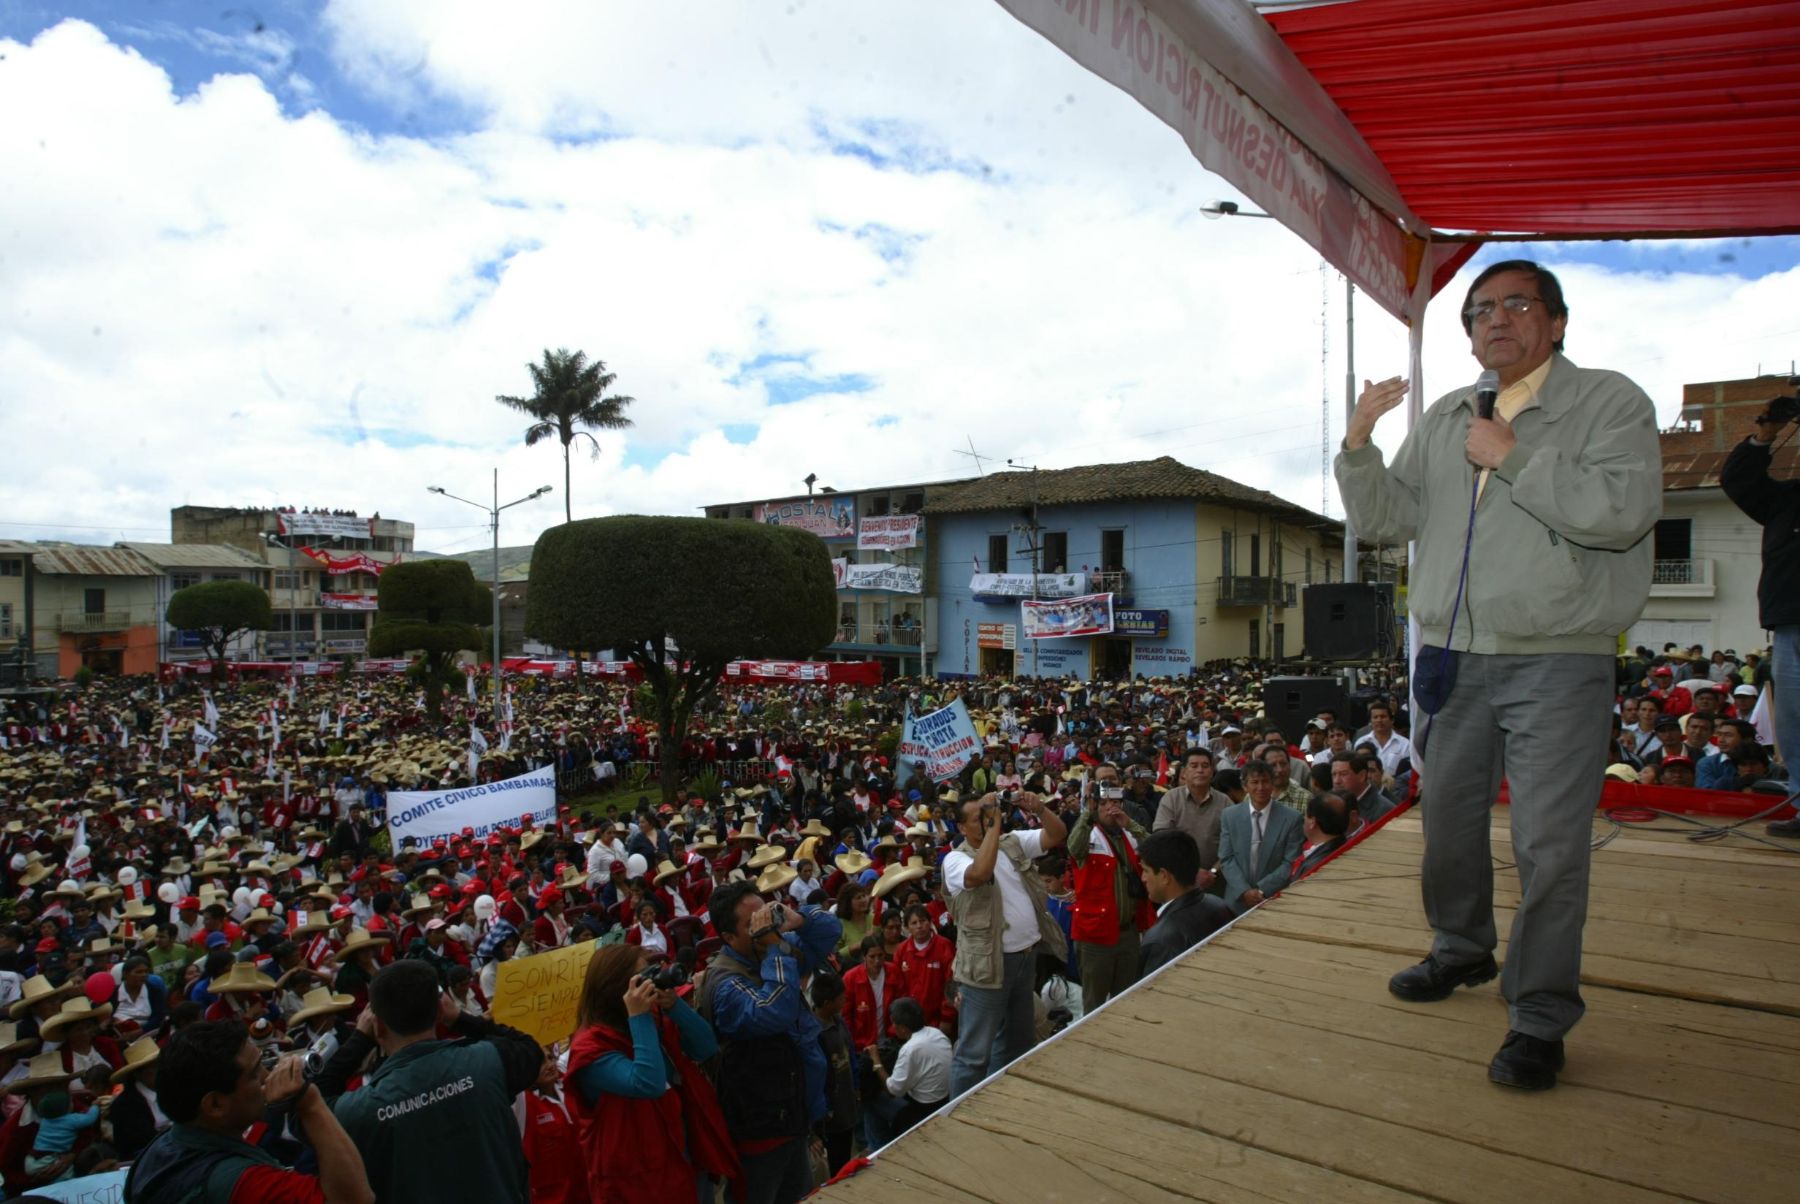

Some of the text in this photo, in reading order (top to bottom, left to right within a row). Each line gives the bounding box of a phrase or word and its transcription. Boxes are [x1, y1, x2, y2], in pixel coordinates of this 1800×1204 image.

[767, 502, 836, 525] HOSTAL
[1115, 611, 1142, 620] FOTO
[390, 797, 446, 828] COMITE
[444, 786, 487, 805] CIVICO
[377, 1076, 475, 1121] COMUNICACIONES
